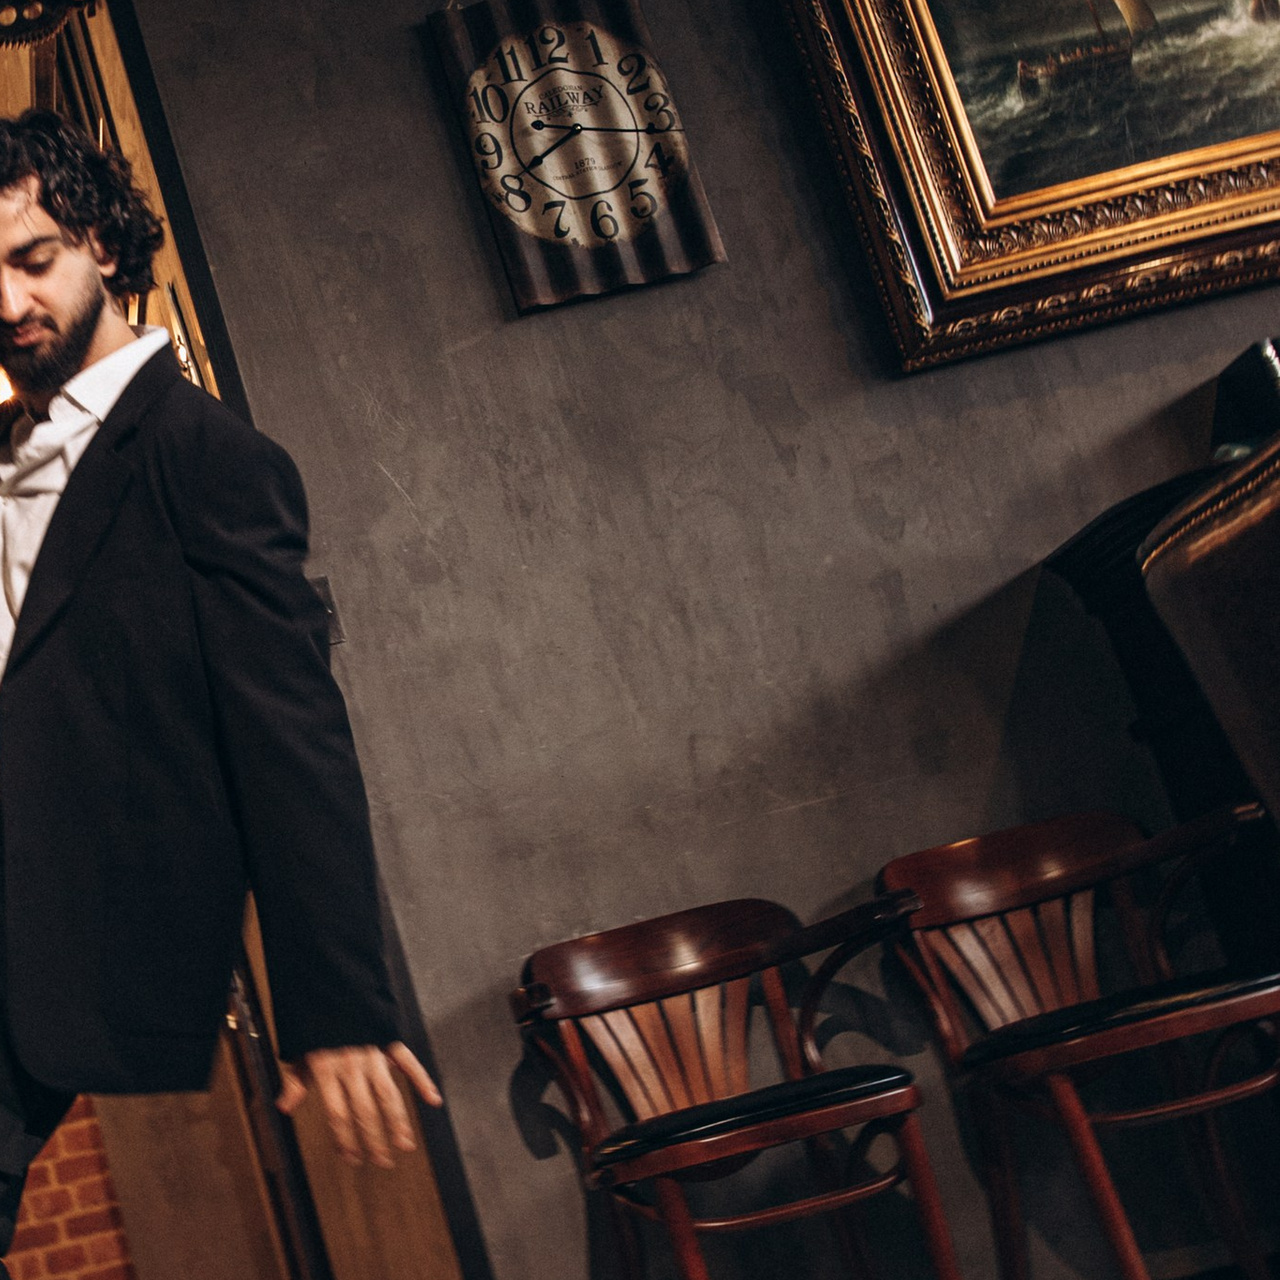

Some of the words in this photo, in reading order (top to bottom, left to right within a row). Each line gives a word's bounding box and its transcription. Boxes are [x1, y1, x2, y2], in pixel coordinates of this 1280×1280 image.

[493, 45, 528, 85] 11
[524, 26, 570, 71] 12
[584, 29, 608, 67] 1
[617, 54, 651, 95] 2
[469, 84, 509, 125] 10
[524, 85, 604, 114] RAILWAY
[644, 92, 676, 134] 3
[475, 132, 503, 170] 9
[574, 157, 596, 169] 1879
[645, 142, 675, 180] 4
[500, 175, 532, 213] 8
[628, 178, 658, 219] 5
[541, 200, 570, 238] 7
[590, 200, 619, 239] 6
